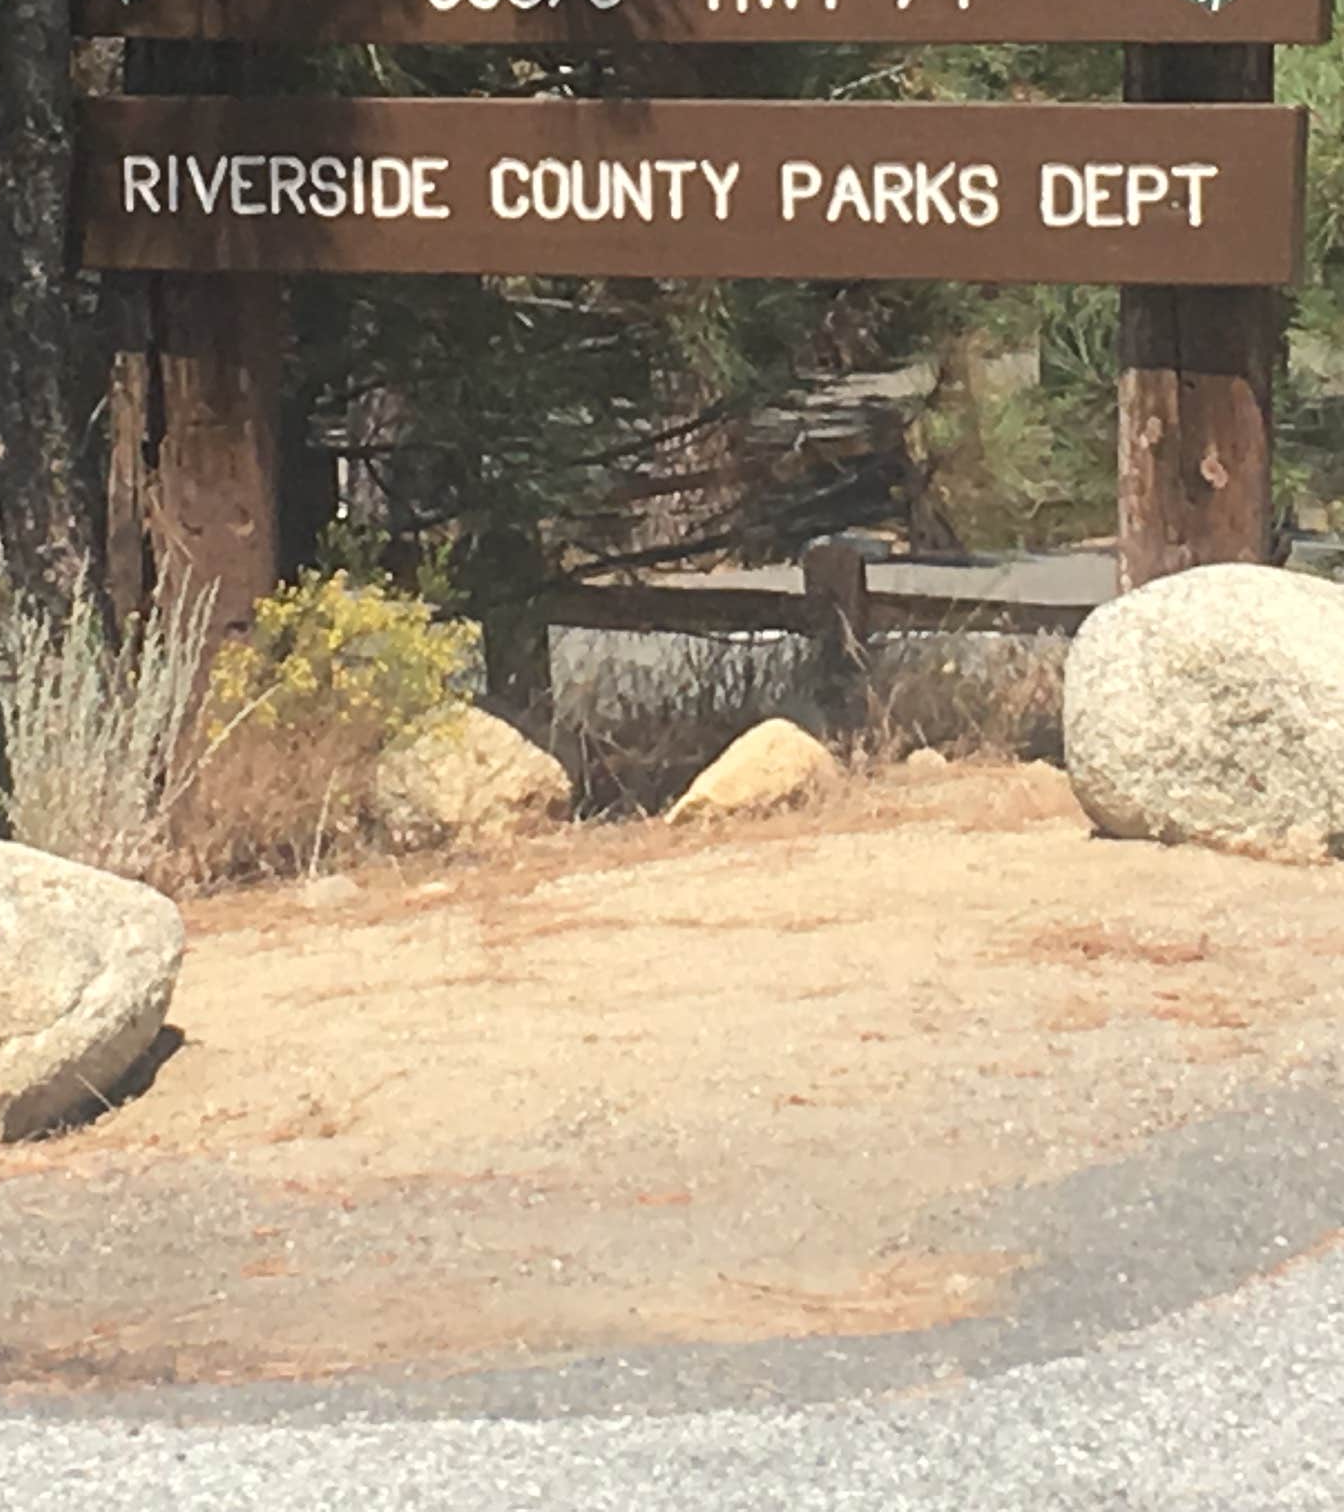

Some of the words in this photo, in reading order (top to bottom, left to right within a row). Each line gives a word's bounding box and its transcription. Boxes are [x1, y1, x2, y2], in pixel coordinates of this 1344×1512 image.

[123, 155, 450, 219] RIVERSIDE
[489, 157, 740, 221] COUNTY
[780, 161, 999, 227] PARKS
[1039, 163, 1219, 228] DEPT
